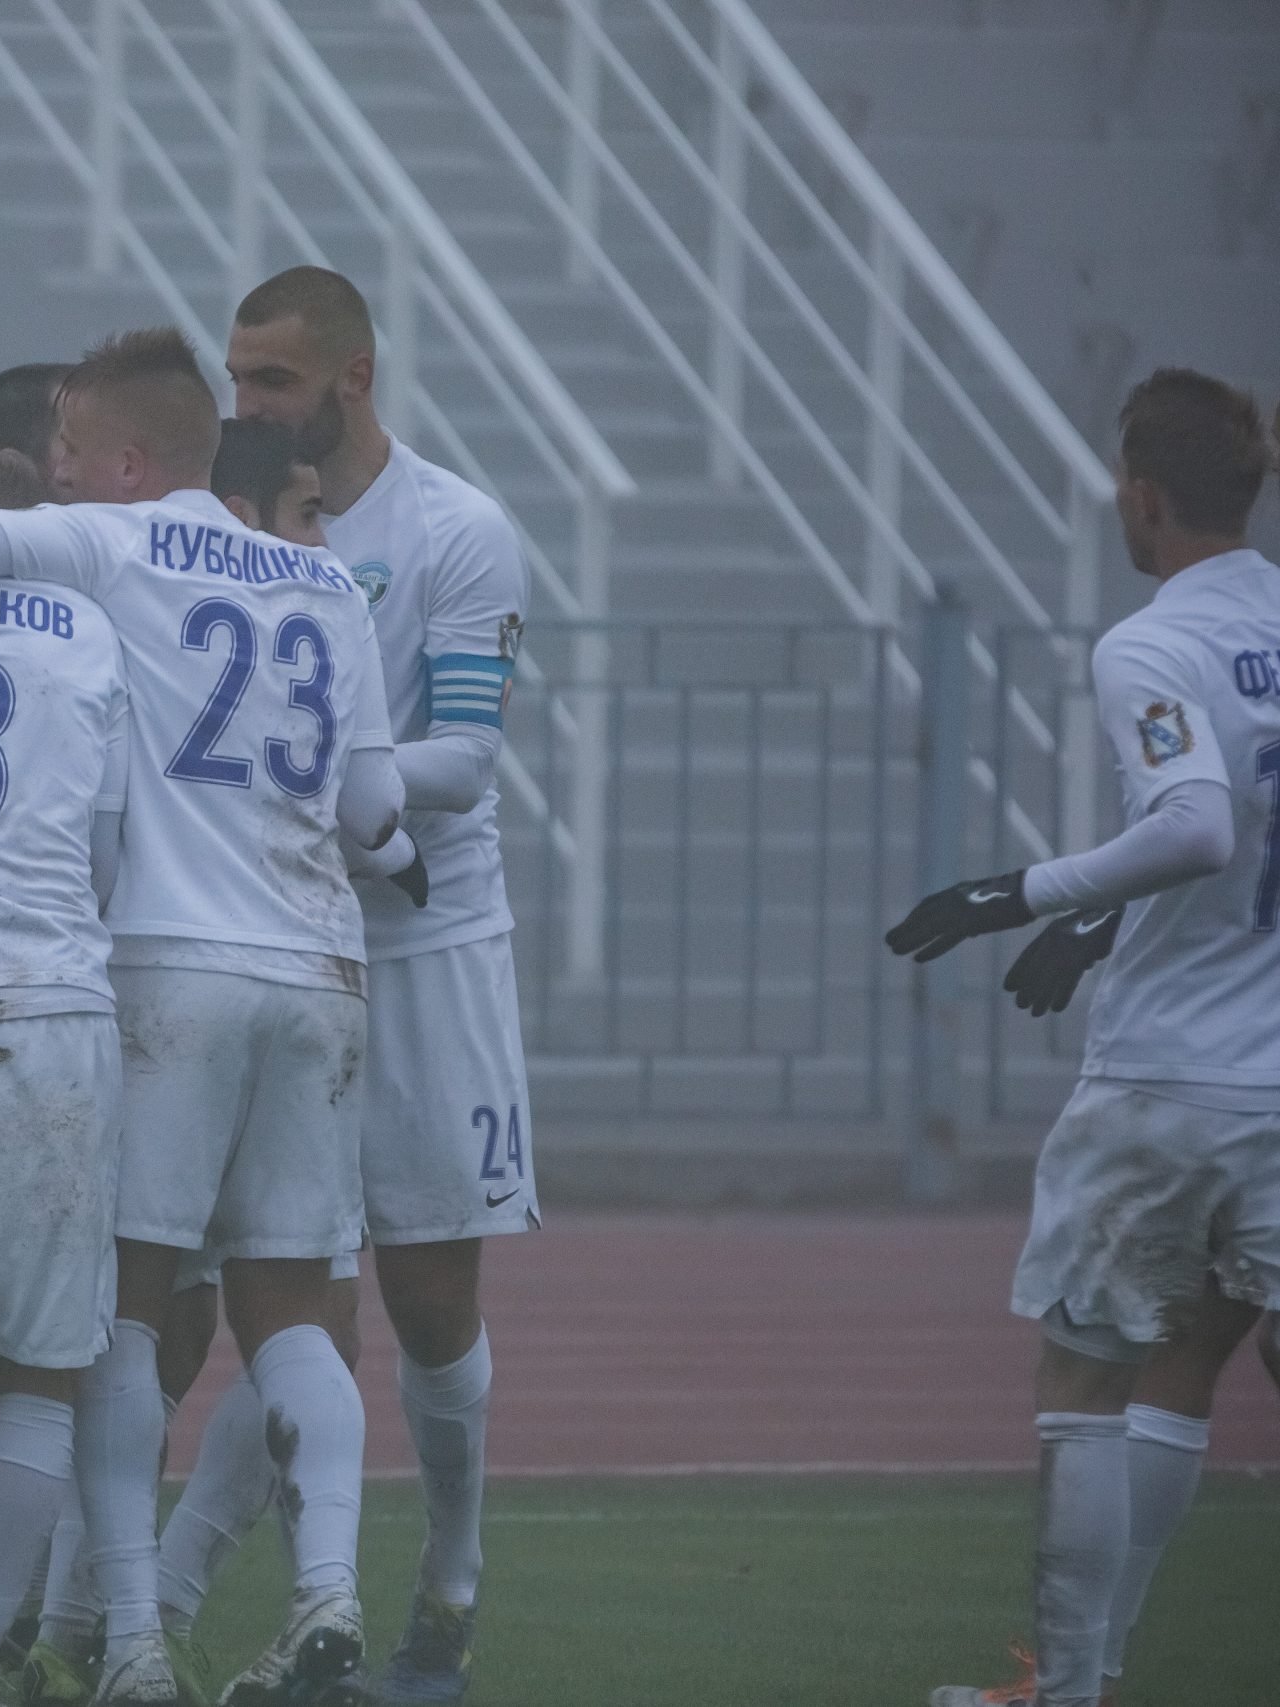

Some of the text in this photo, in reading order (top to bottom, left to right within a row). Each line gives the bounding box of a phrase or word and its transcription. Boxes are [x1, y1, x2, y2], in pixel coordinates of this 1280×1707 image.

[151, 522, 353, 592] КУБЫШКИН
[164, 596, 337, 799] 23
[471, 1103, 524, 1181] 24
